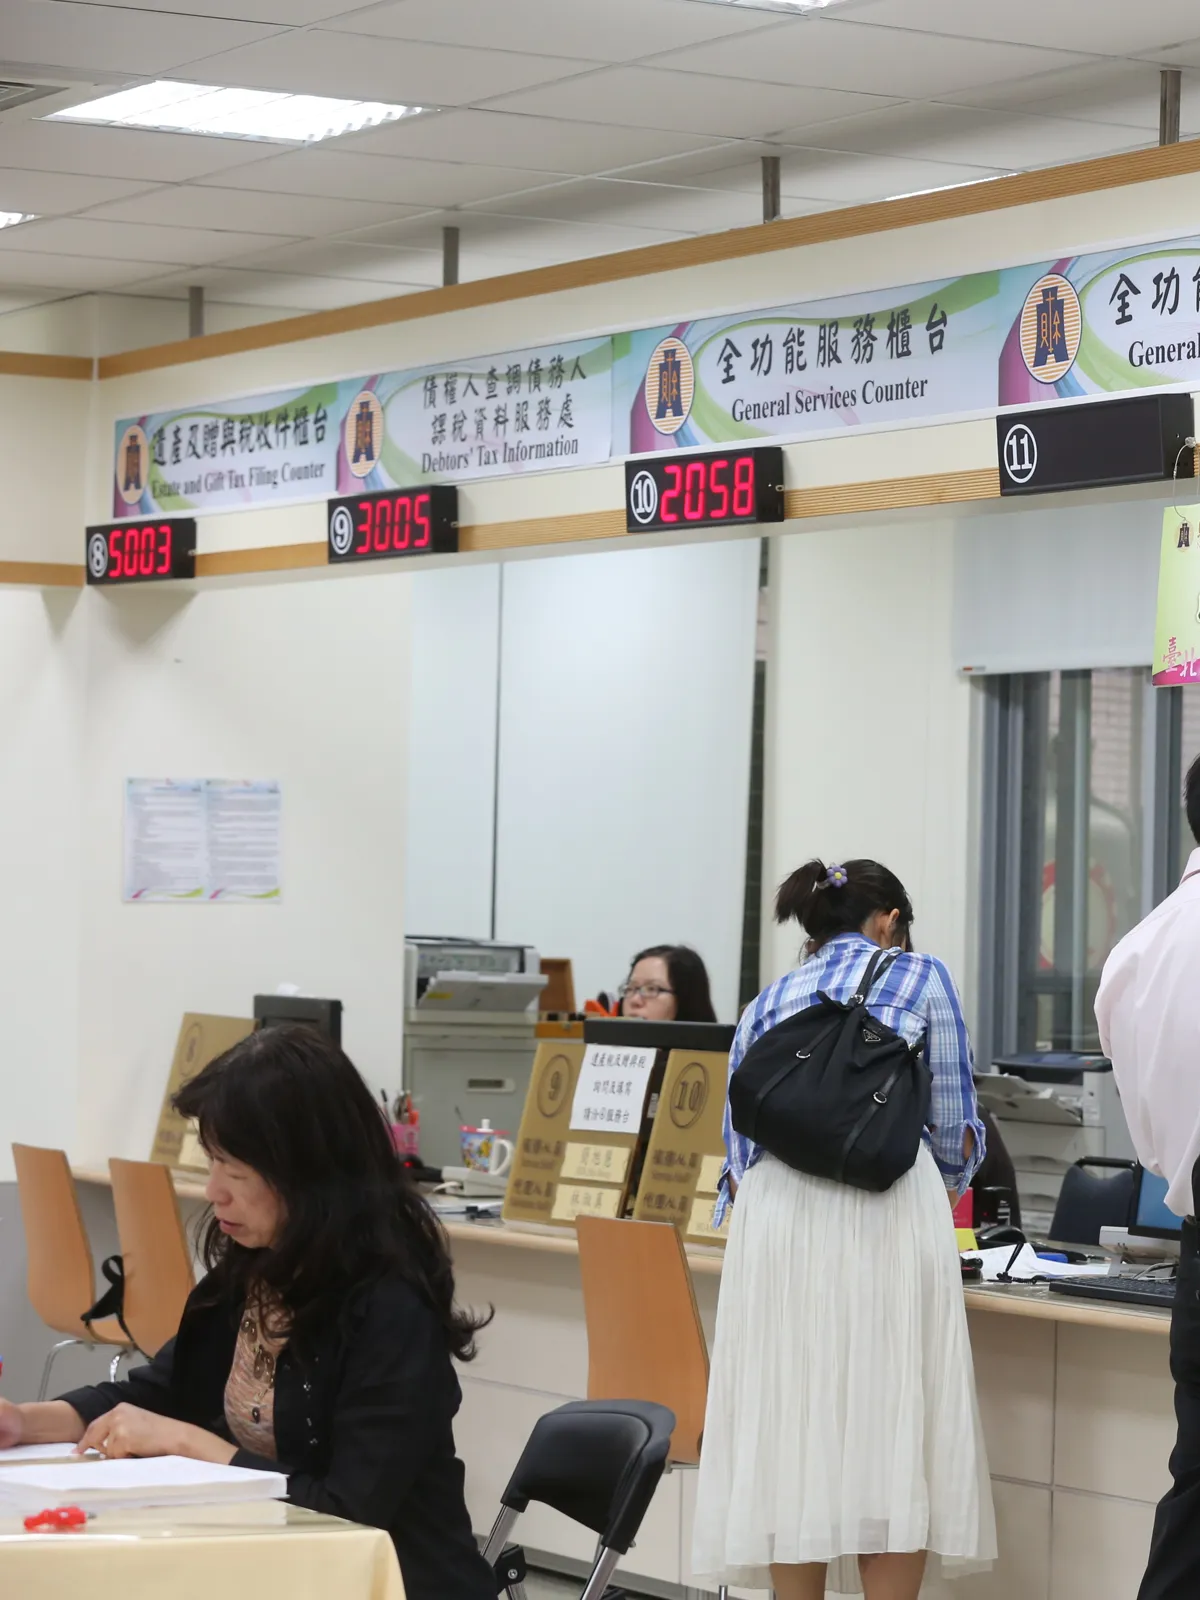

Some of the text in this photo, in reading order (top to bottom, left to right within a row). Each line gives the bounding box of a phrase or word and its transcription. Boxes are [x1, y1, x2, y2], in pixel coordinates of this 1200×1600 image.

[716, 303, 948, 385] 全功能服務櫃台
[423, 355, 587, 410] 債權人查調債務人
[732, 377, 928, 422] General Services Counter
[152, 402, 328, 467] 遺產及贈與稅收件櫃台
[431, 393, 574, 445] 課稅資料服務處
[477, 444, 499, 467] Tax
[502, 434, 579, 463] Information
[1006, 435, 1034, 474] 11
[152, 461, 326, 499] Estate and Gift Tax Filing Counter
[631, 456, 754, 522] 10 2058
[333, 494, 430, 554] 9 3005
[90, 525, 172, 578] 8 5003
[674, 1079, 702, 1112] 10
